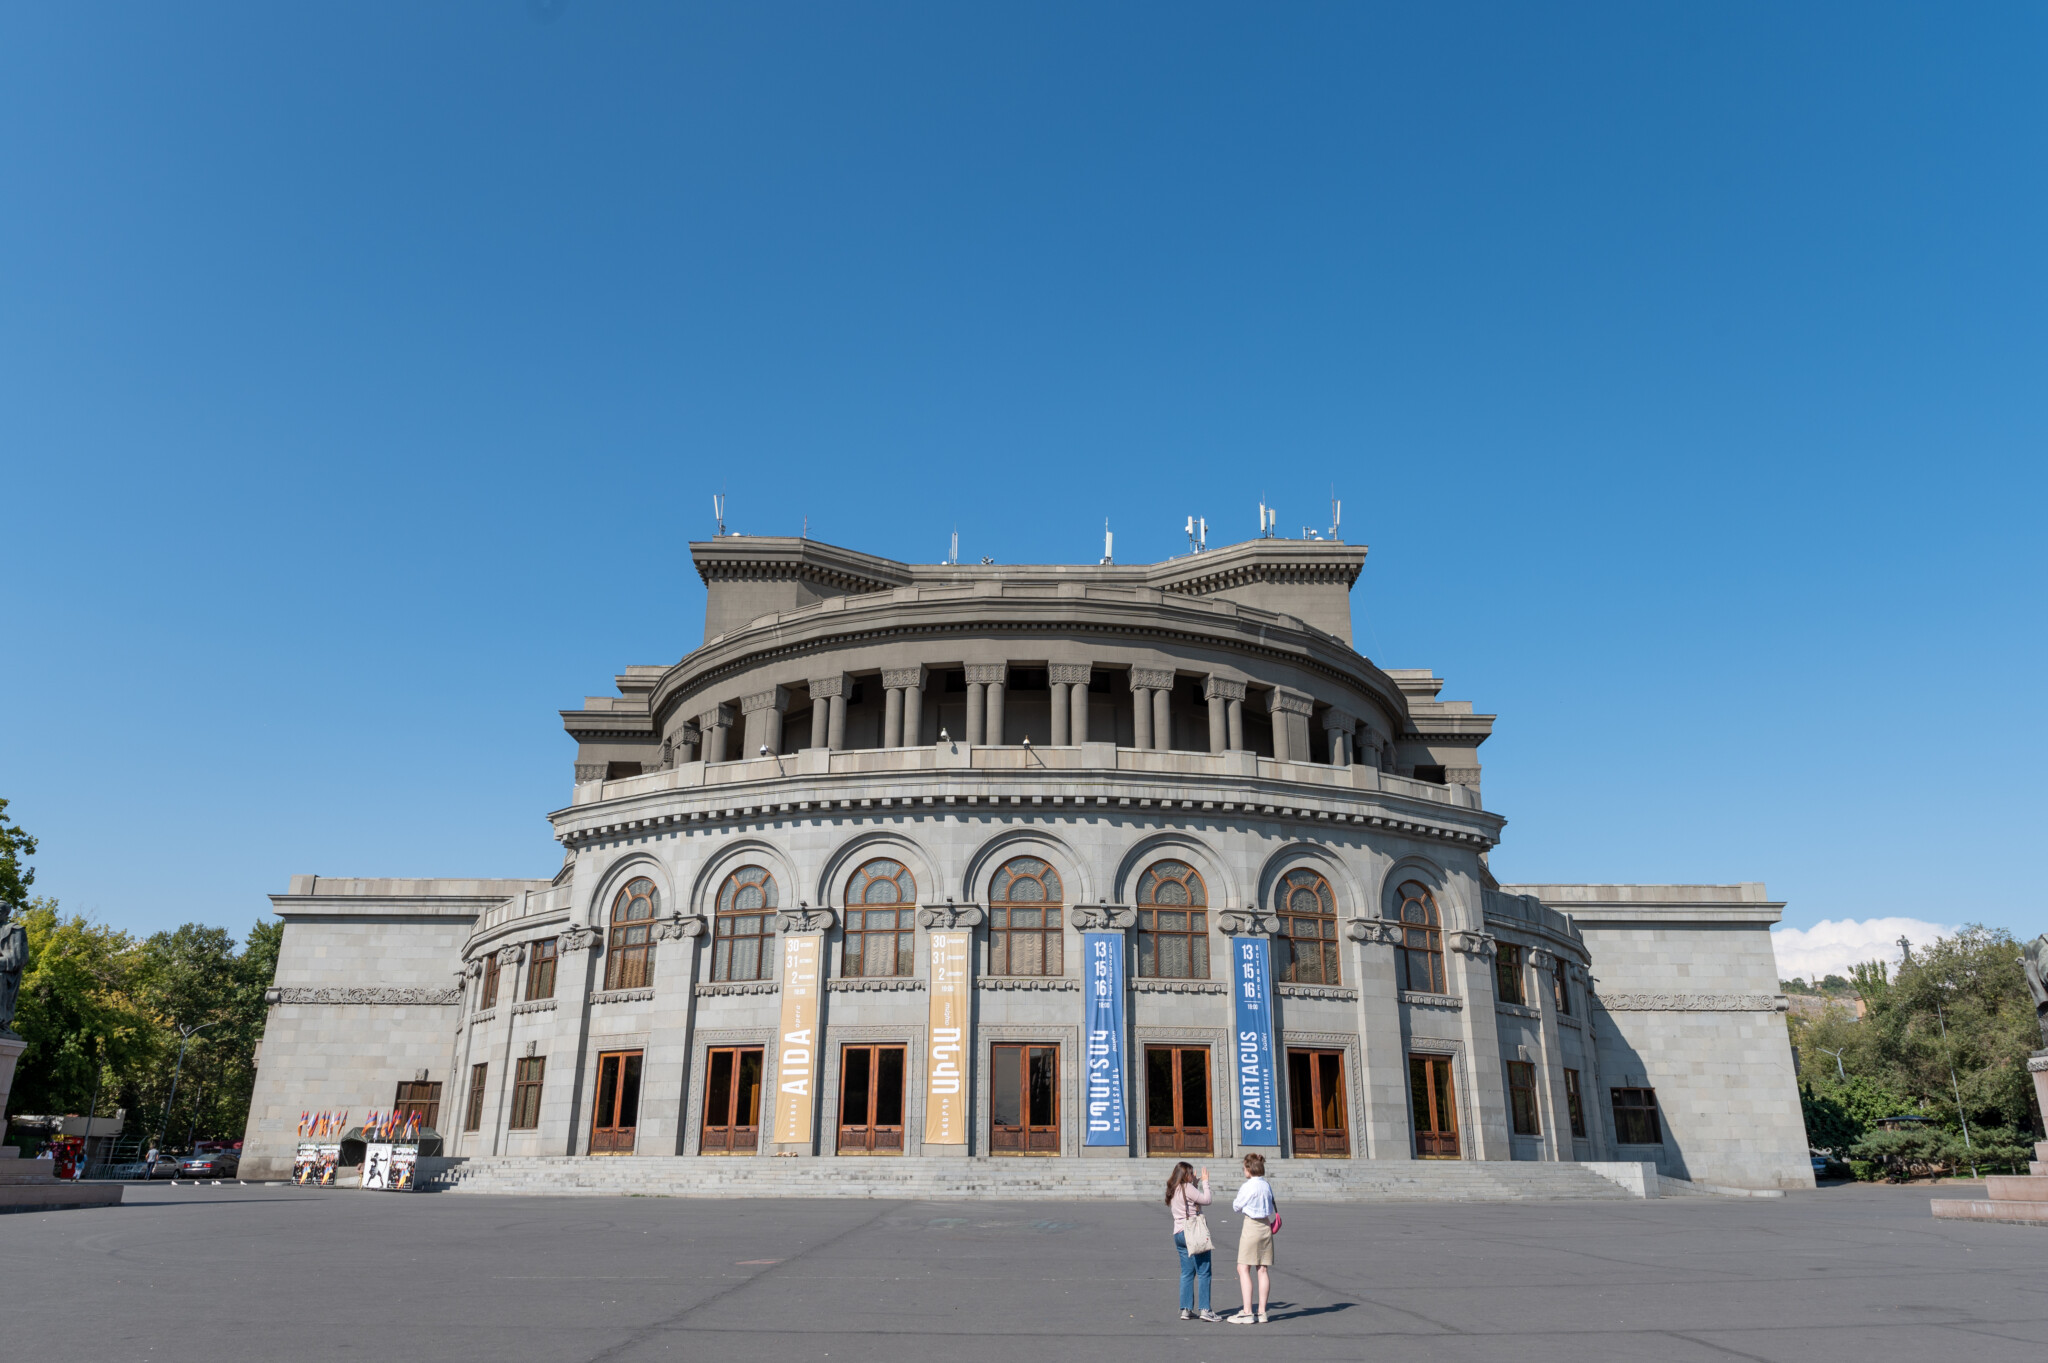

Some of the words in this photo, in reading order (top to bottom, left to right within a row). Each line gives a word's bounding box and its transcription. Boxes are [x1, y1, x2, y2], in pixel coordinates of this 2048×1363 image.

[787, 939, 800, 952] 30
[933, 935, 946, 948] 30
[1094, 941, 1106, 958] 13
[932, 951, 945, 964] 31
[1242, 944, 1253, 960] 13
[786, 955, 798, 968] 31
[1094, 960, 1106, 977] 15
[792, 971, 798, 984] 2
[938, 968, 944, 980] 2
[1242, 963, 1254, 979] 15
[1094, 980, 1107, 996] 16
[1243, 982, 1255, 998] 16
[781, 1029, 811, 1096] AIDA
[932, 1027, 960, 1094] ԱԻԴԱ
[1089, 1030, 1111, 1131] ՍՊԱՐՏԱԿ
[1240, 1031, 1262, 1131] SPARTACUS
[1262, 1068, 1272, 1122] KHACHATURIAN
